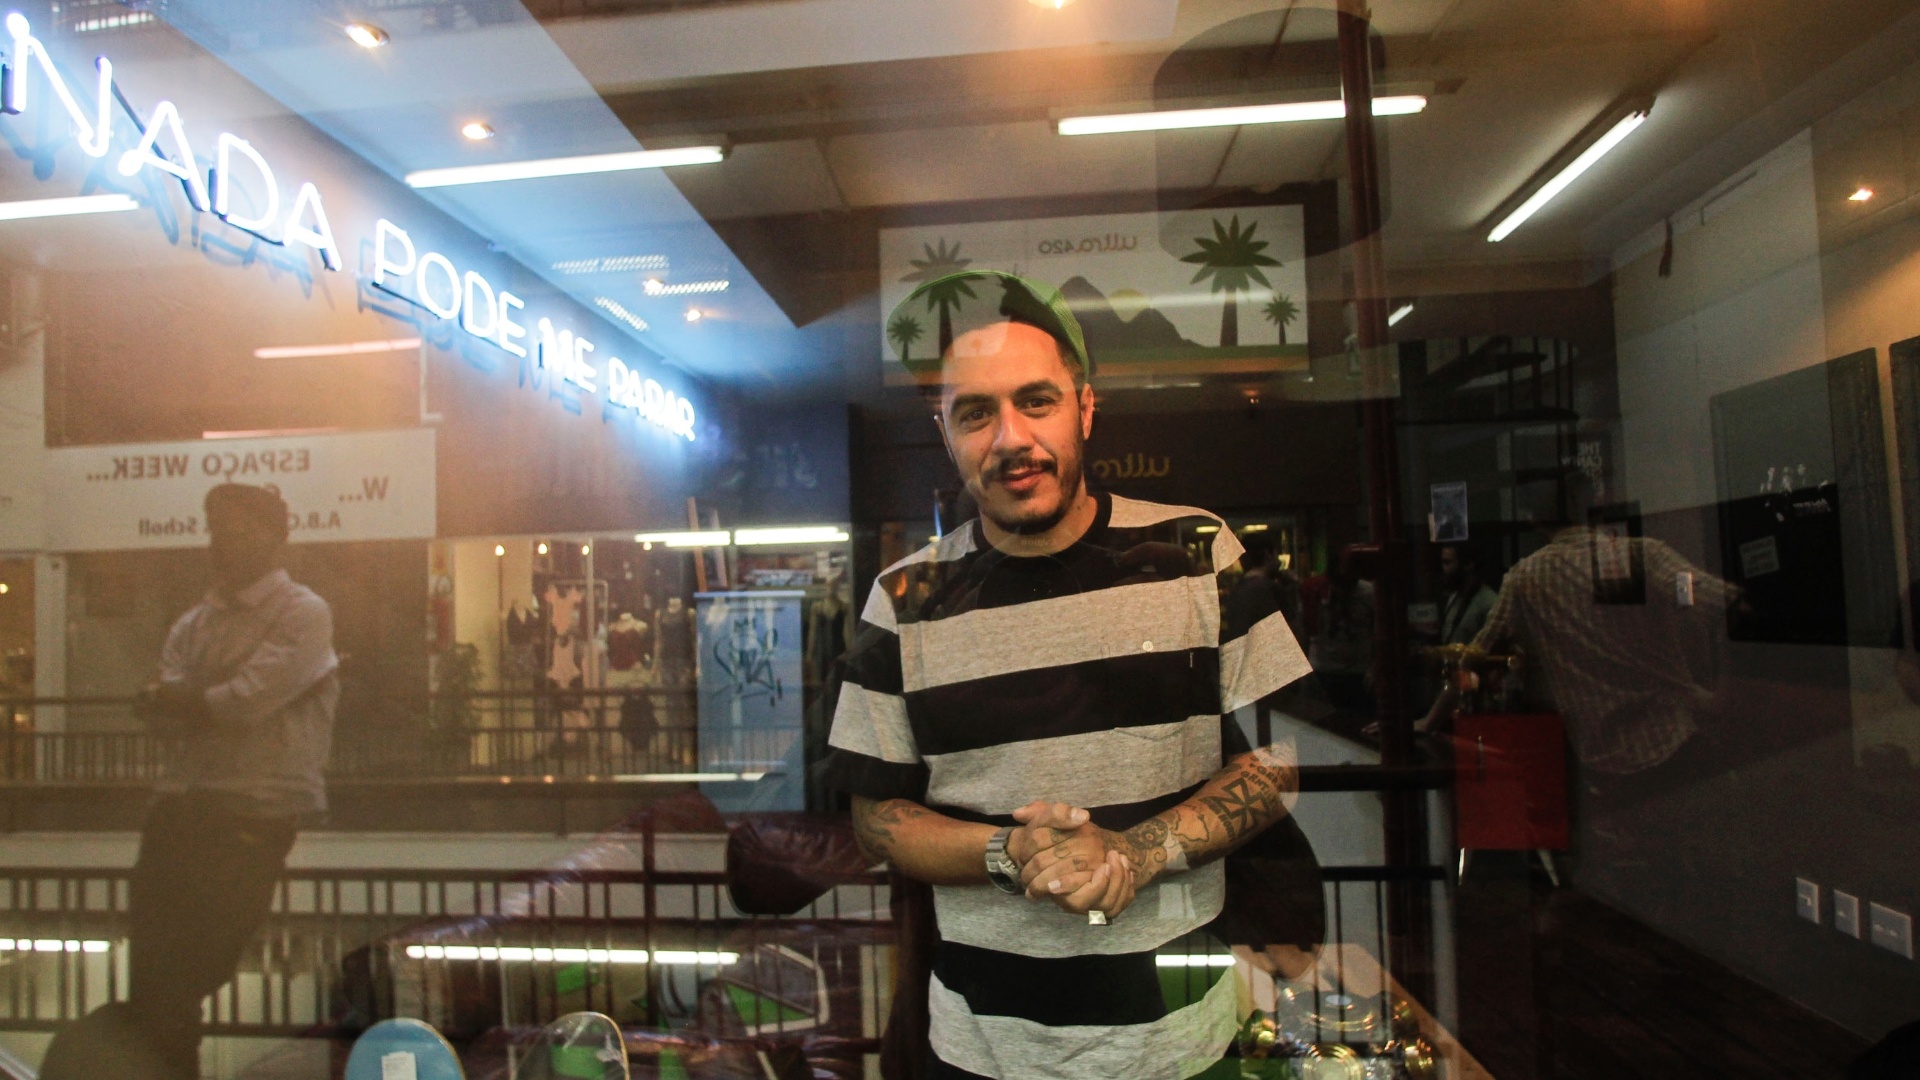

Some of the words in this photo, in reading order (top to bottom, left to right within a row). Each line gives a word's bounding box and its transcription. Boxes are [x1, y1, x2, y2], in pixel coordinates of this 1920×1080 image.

[6, 12, 342, 272] NADA
[374, 217, 527, 359] PODE
[538, 317, 597, 394] ME
[608, 356, 696, 442] PARAR
